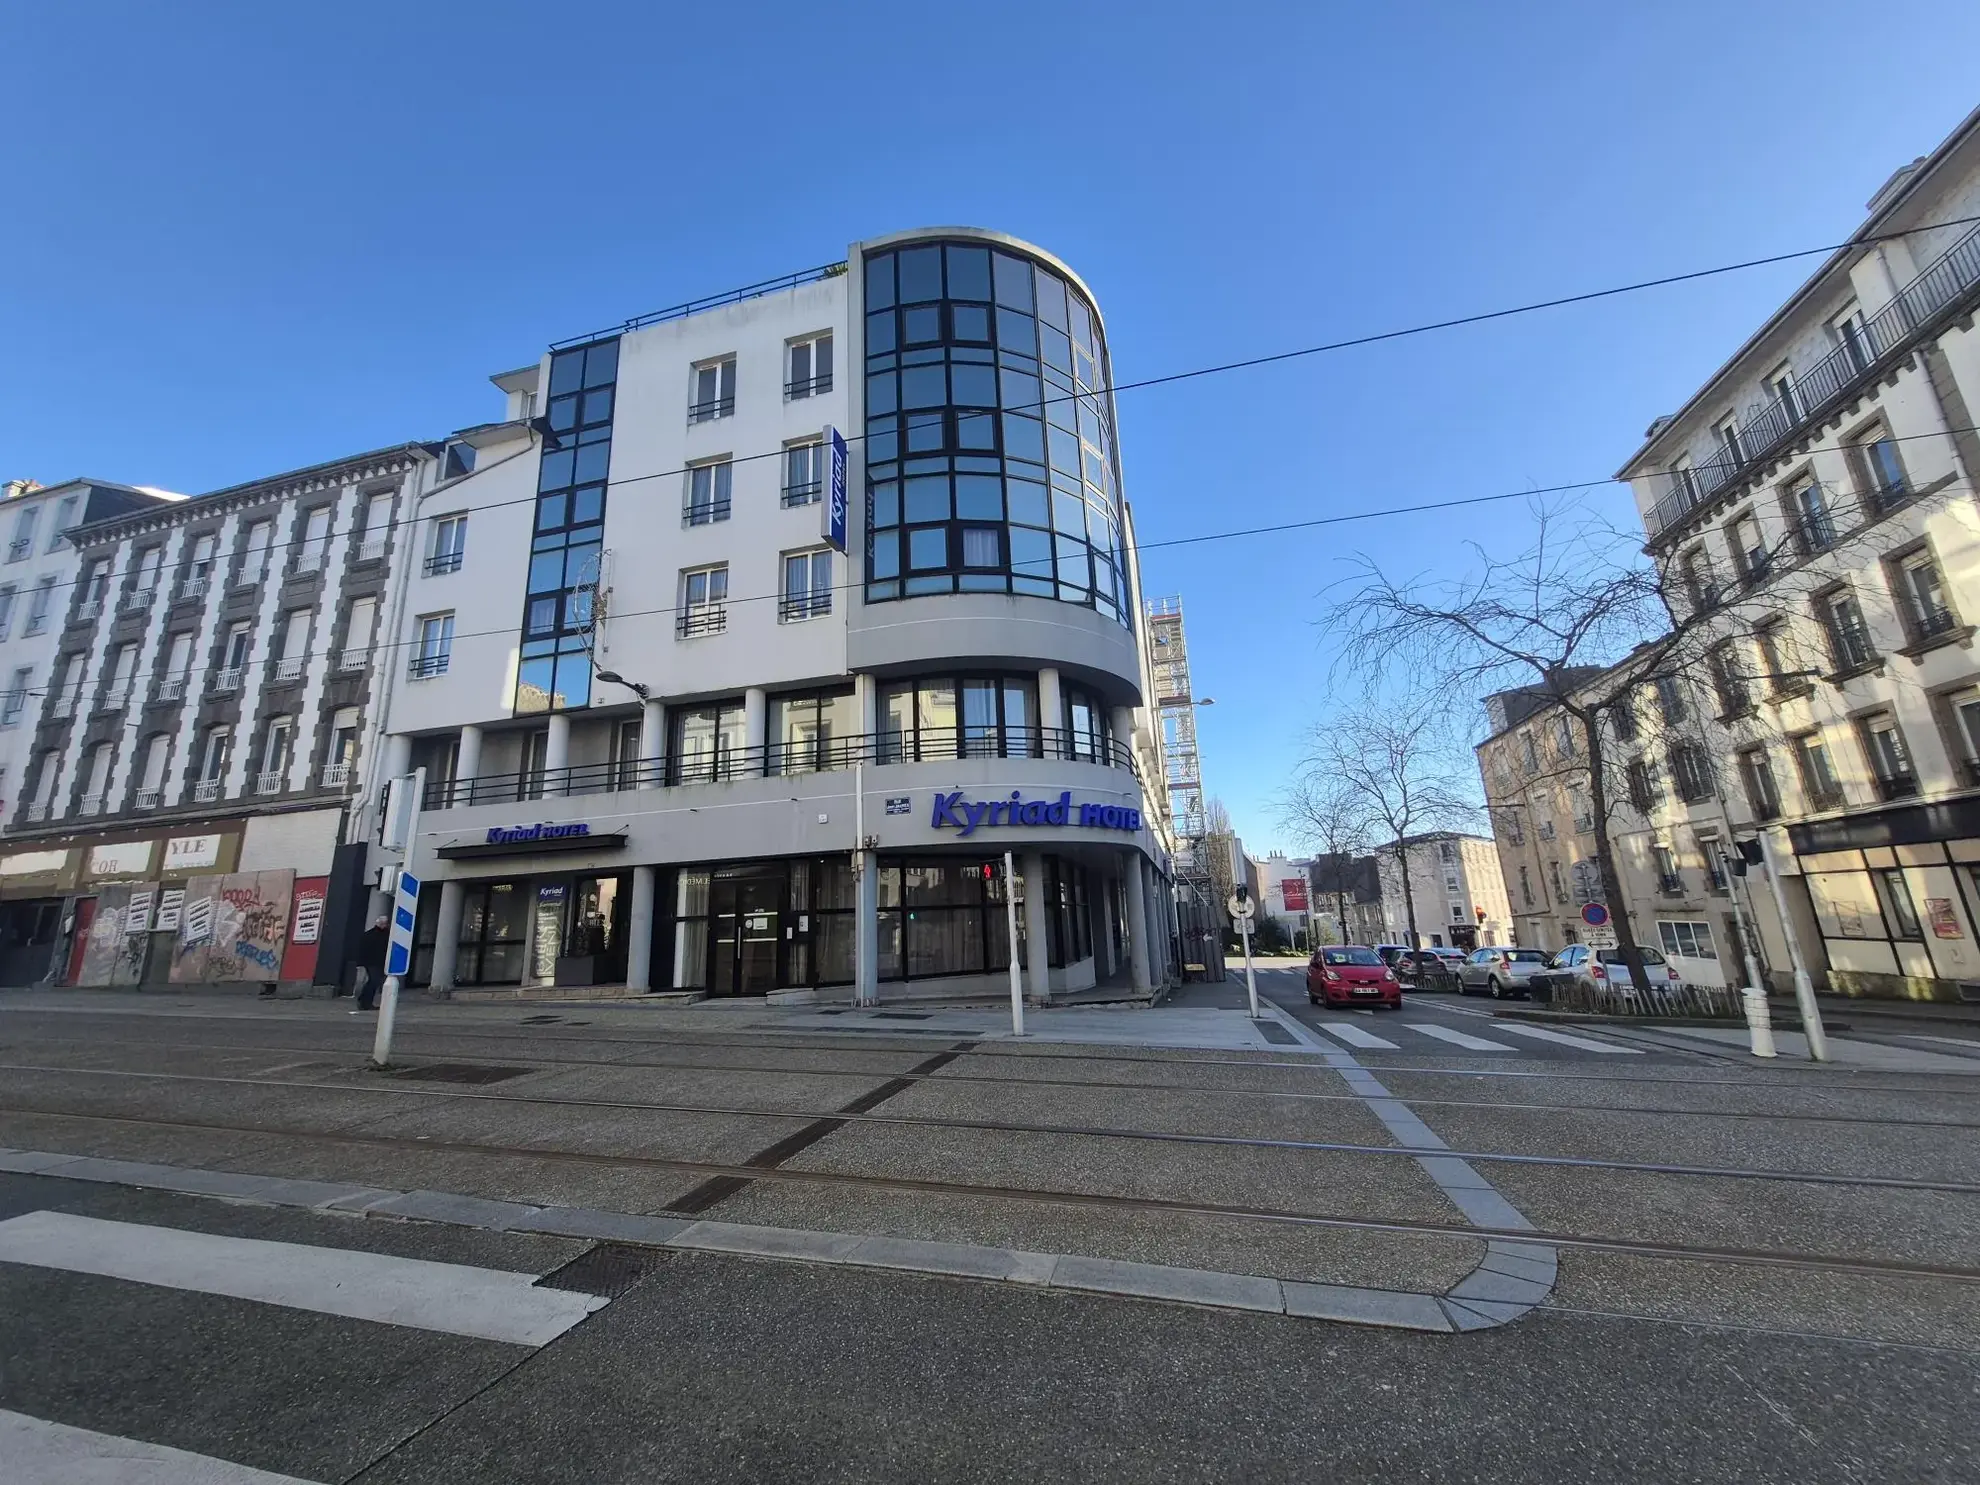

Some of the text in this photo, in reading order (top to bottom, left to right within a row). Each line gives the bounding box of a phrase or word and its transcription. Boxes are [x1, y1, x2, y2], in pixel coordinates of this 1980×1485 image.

[832, 447, 844, 526] Kyriad
[931, 791, 1142, 837] Kyriad HOTEL
[485, 823, 590, 843] Kyriad HOTEL
[540, 887, 563, 896] Kyriad
